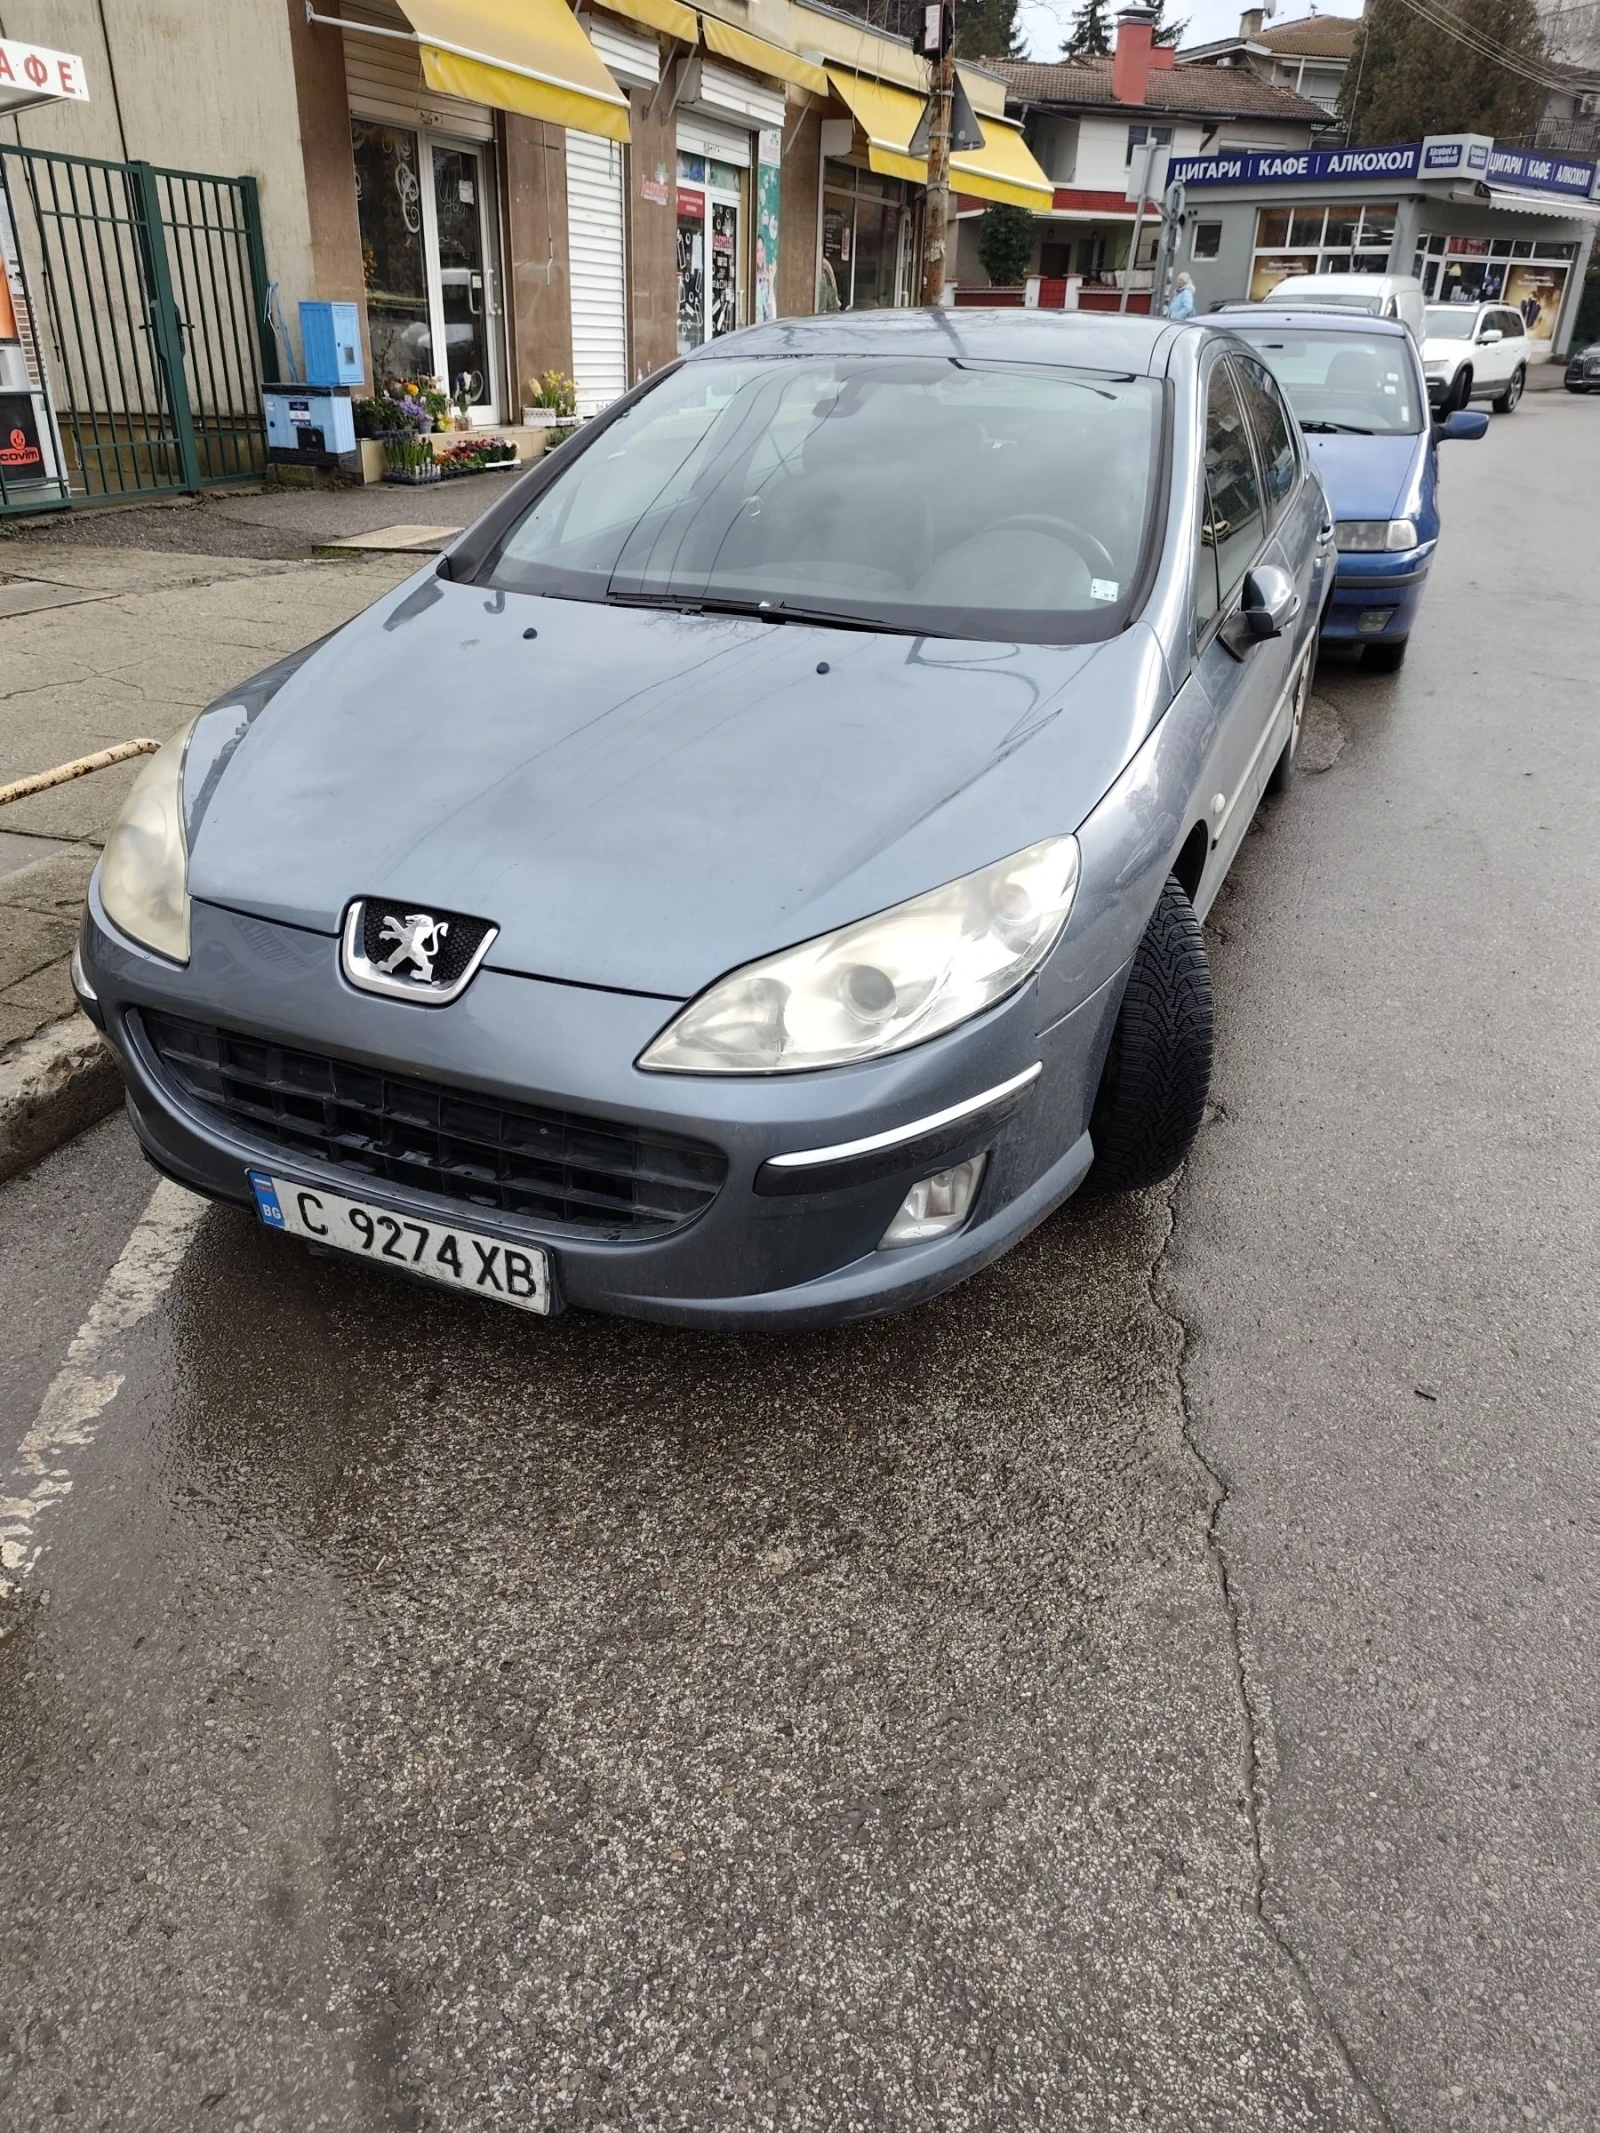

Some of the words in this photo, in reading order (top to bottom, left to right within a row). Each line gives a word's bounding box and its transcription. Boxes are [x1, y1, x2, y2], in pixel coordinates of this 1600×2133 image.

[1174, 160, 1241, 183] ЦИГАРИ
[1258, 157, 1309, 176] КАФЕ
[1327, 151, 1415, 173] АЛКОХОЛ
[1488, 152, 1523, 175] ЦИГАРИ
[1527, 162, 1552, 181] КАФЕ
[1555, 165, 1592, 187] АЛКОХОЛ
[0, 449, 38, 462] covim
[261, 1203, 281, 1220] BG
[297, 1191, 329, 1236] C
